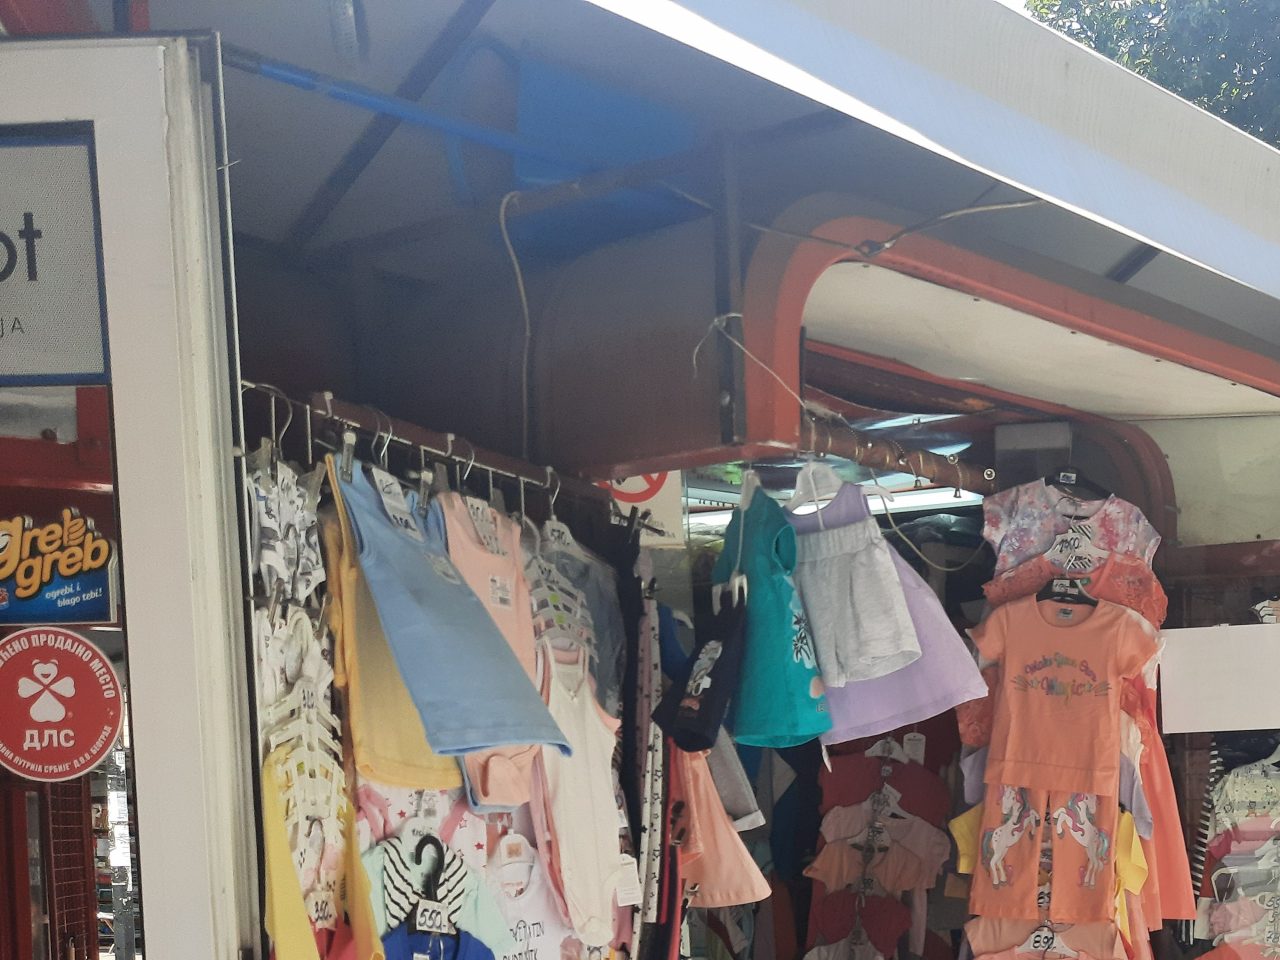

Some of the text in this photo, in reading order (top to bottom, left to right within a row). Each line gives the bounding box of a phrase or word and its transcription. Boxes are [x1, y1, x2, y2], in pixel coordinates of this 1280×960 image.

[15, 532, 109, 598] greb
[31, 633, 93, 662] ПРОДАЈНО
[90, 658, 116, 699] МЕСТО
[22, 729, 75, 751] ДЛС
